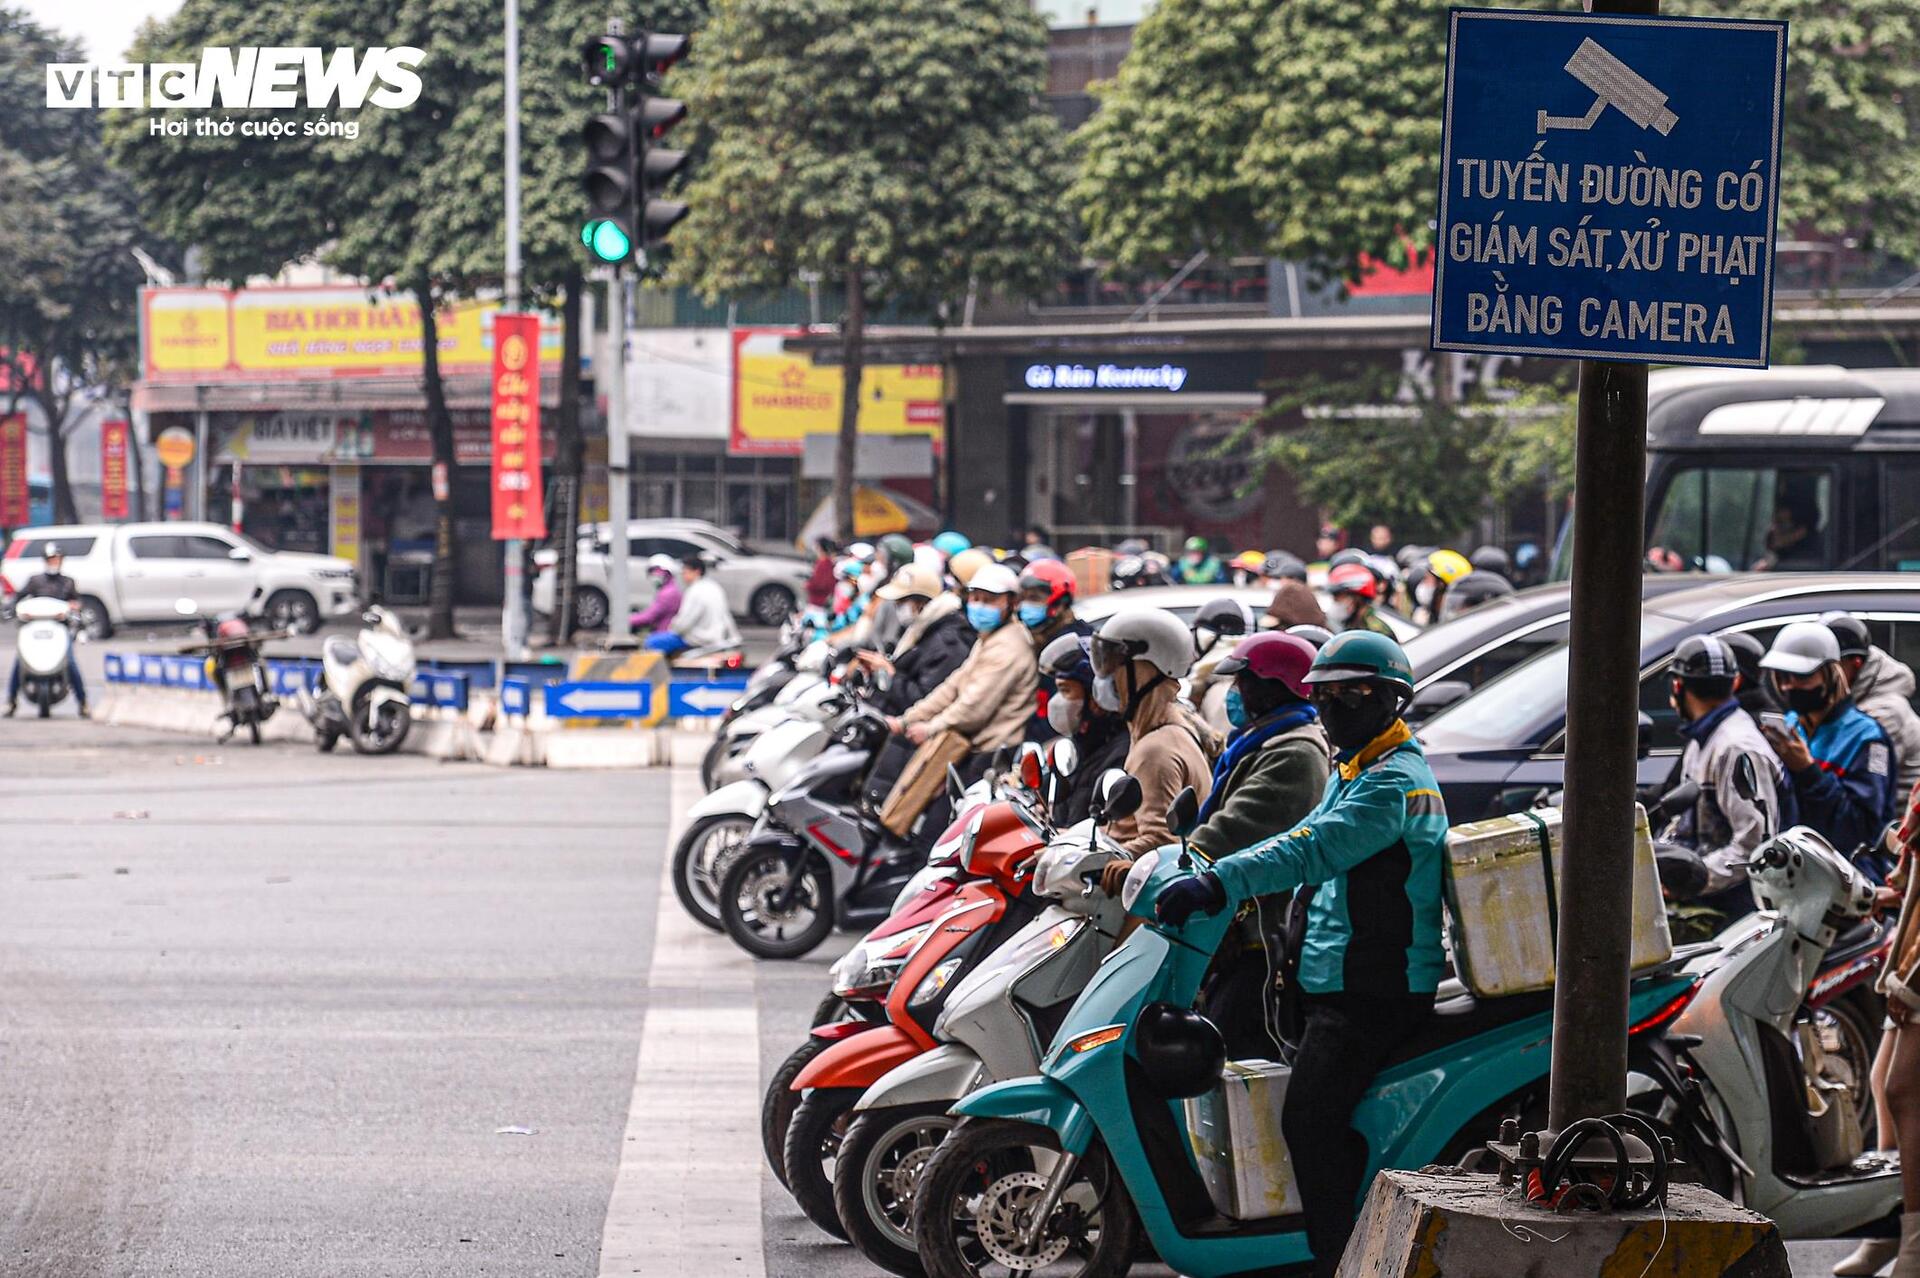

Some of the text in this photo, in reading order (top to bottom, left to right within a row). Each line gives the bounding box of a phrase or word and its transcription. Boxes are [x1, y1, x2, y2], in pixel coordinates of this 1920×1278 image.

[1457, 141, 1763, 212] TUYẾN ĐƯỜNG CÓ
[1450, 210, 1538, 266] GIÁM
[1677, 232, 1765, 285] PHẠT
[1467, 271, 1735, 345] BẰNG CAMERA
[1096, 364, 1187, 391] Kentucky
[1396, 350, 1521, 400] KFC
